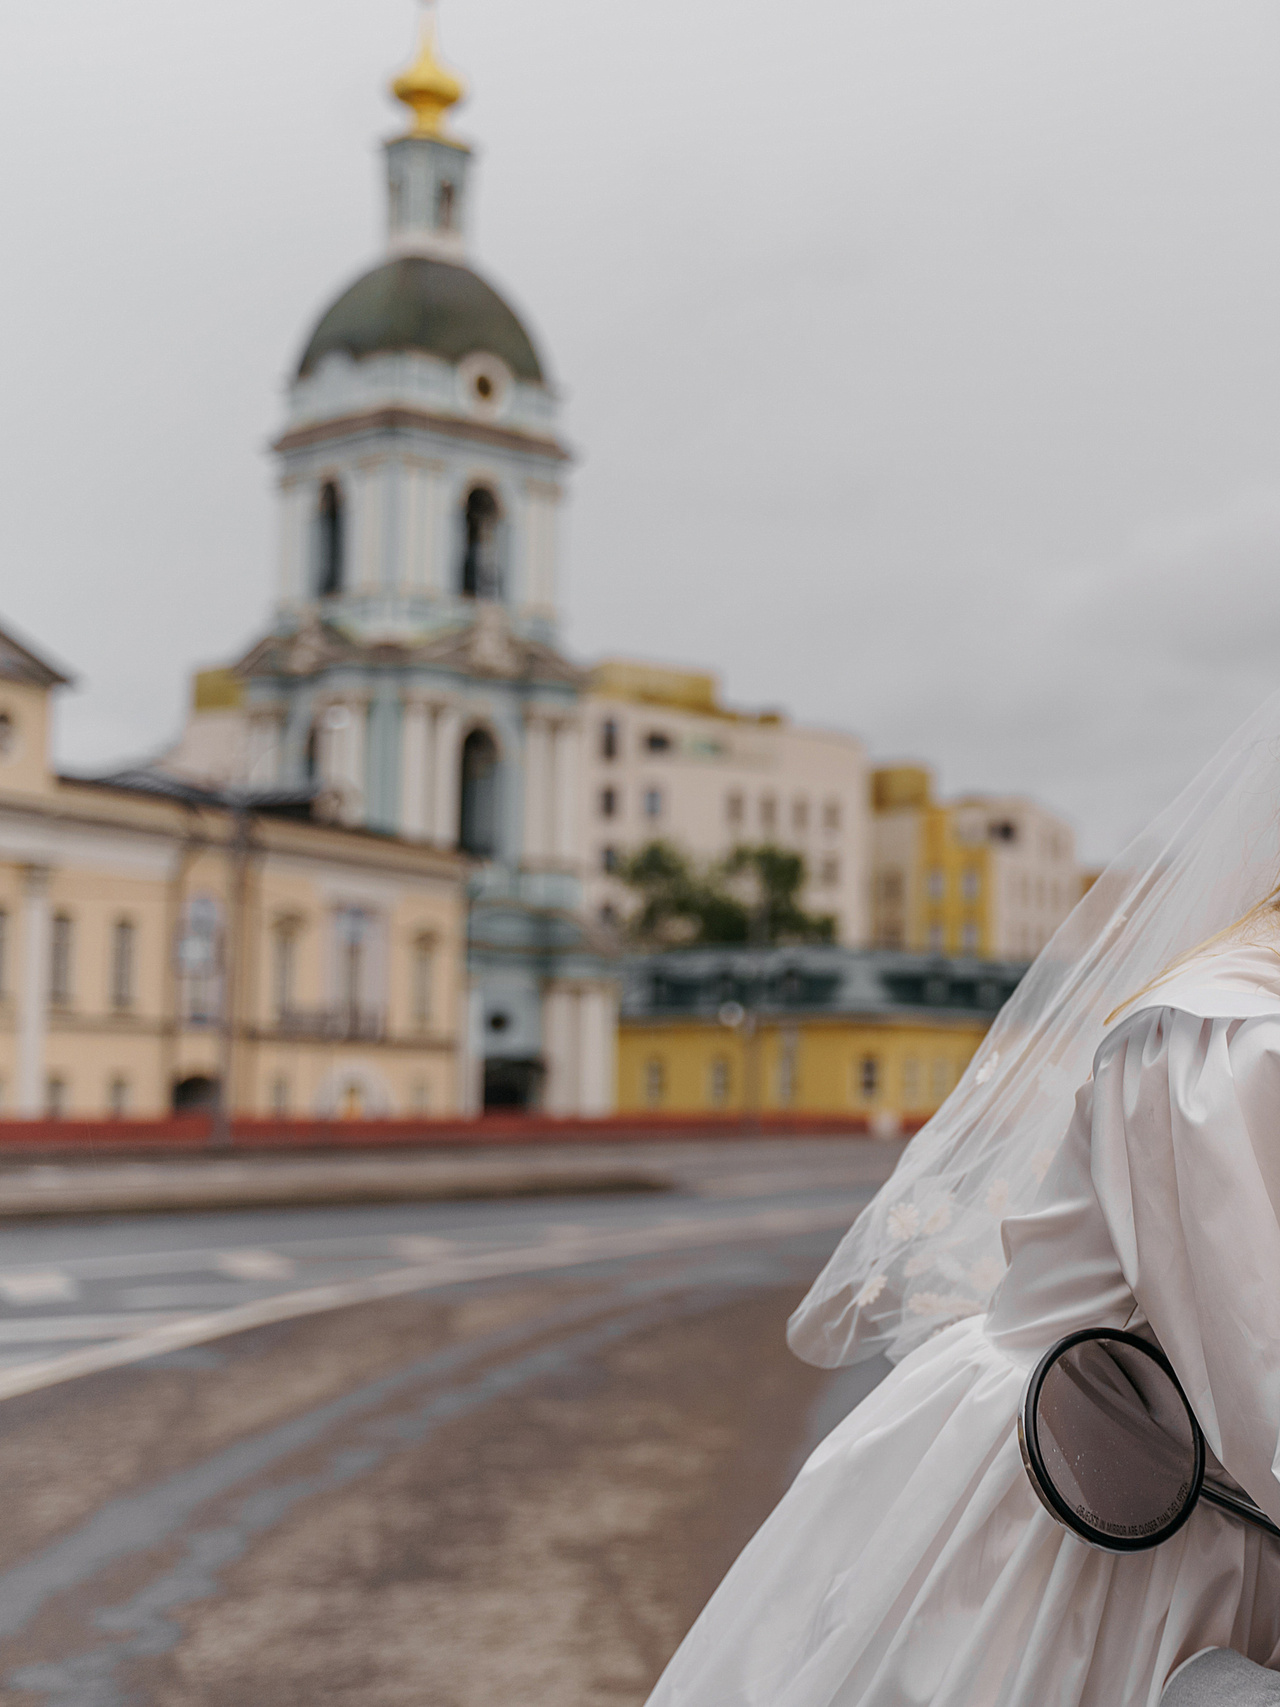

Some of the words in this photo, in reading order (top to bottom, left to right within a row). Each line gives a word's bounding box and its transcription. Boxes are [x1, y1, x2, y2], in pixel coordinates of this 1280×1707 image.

[1076, 1504, 1099, 1527] OBJECTS
[1107, 1521, 1127, 1535] MIRROR
[1127, 1524, 1139, 1536] ARE
[1139, 1519, 1158, 1535] CLOSER
[1156, 1511, 1171, 1526] THAN
[1167, 1499, 1180, 1516] THEY
[1176, 1482, 1190, 1503] APPEA
